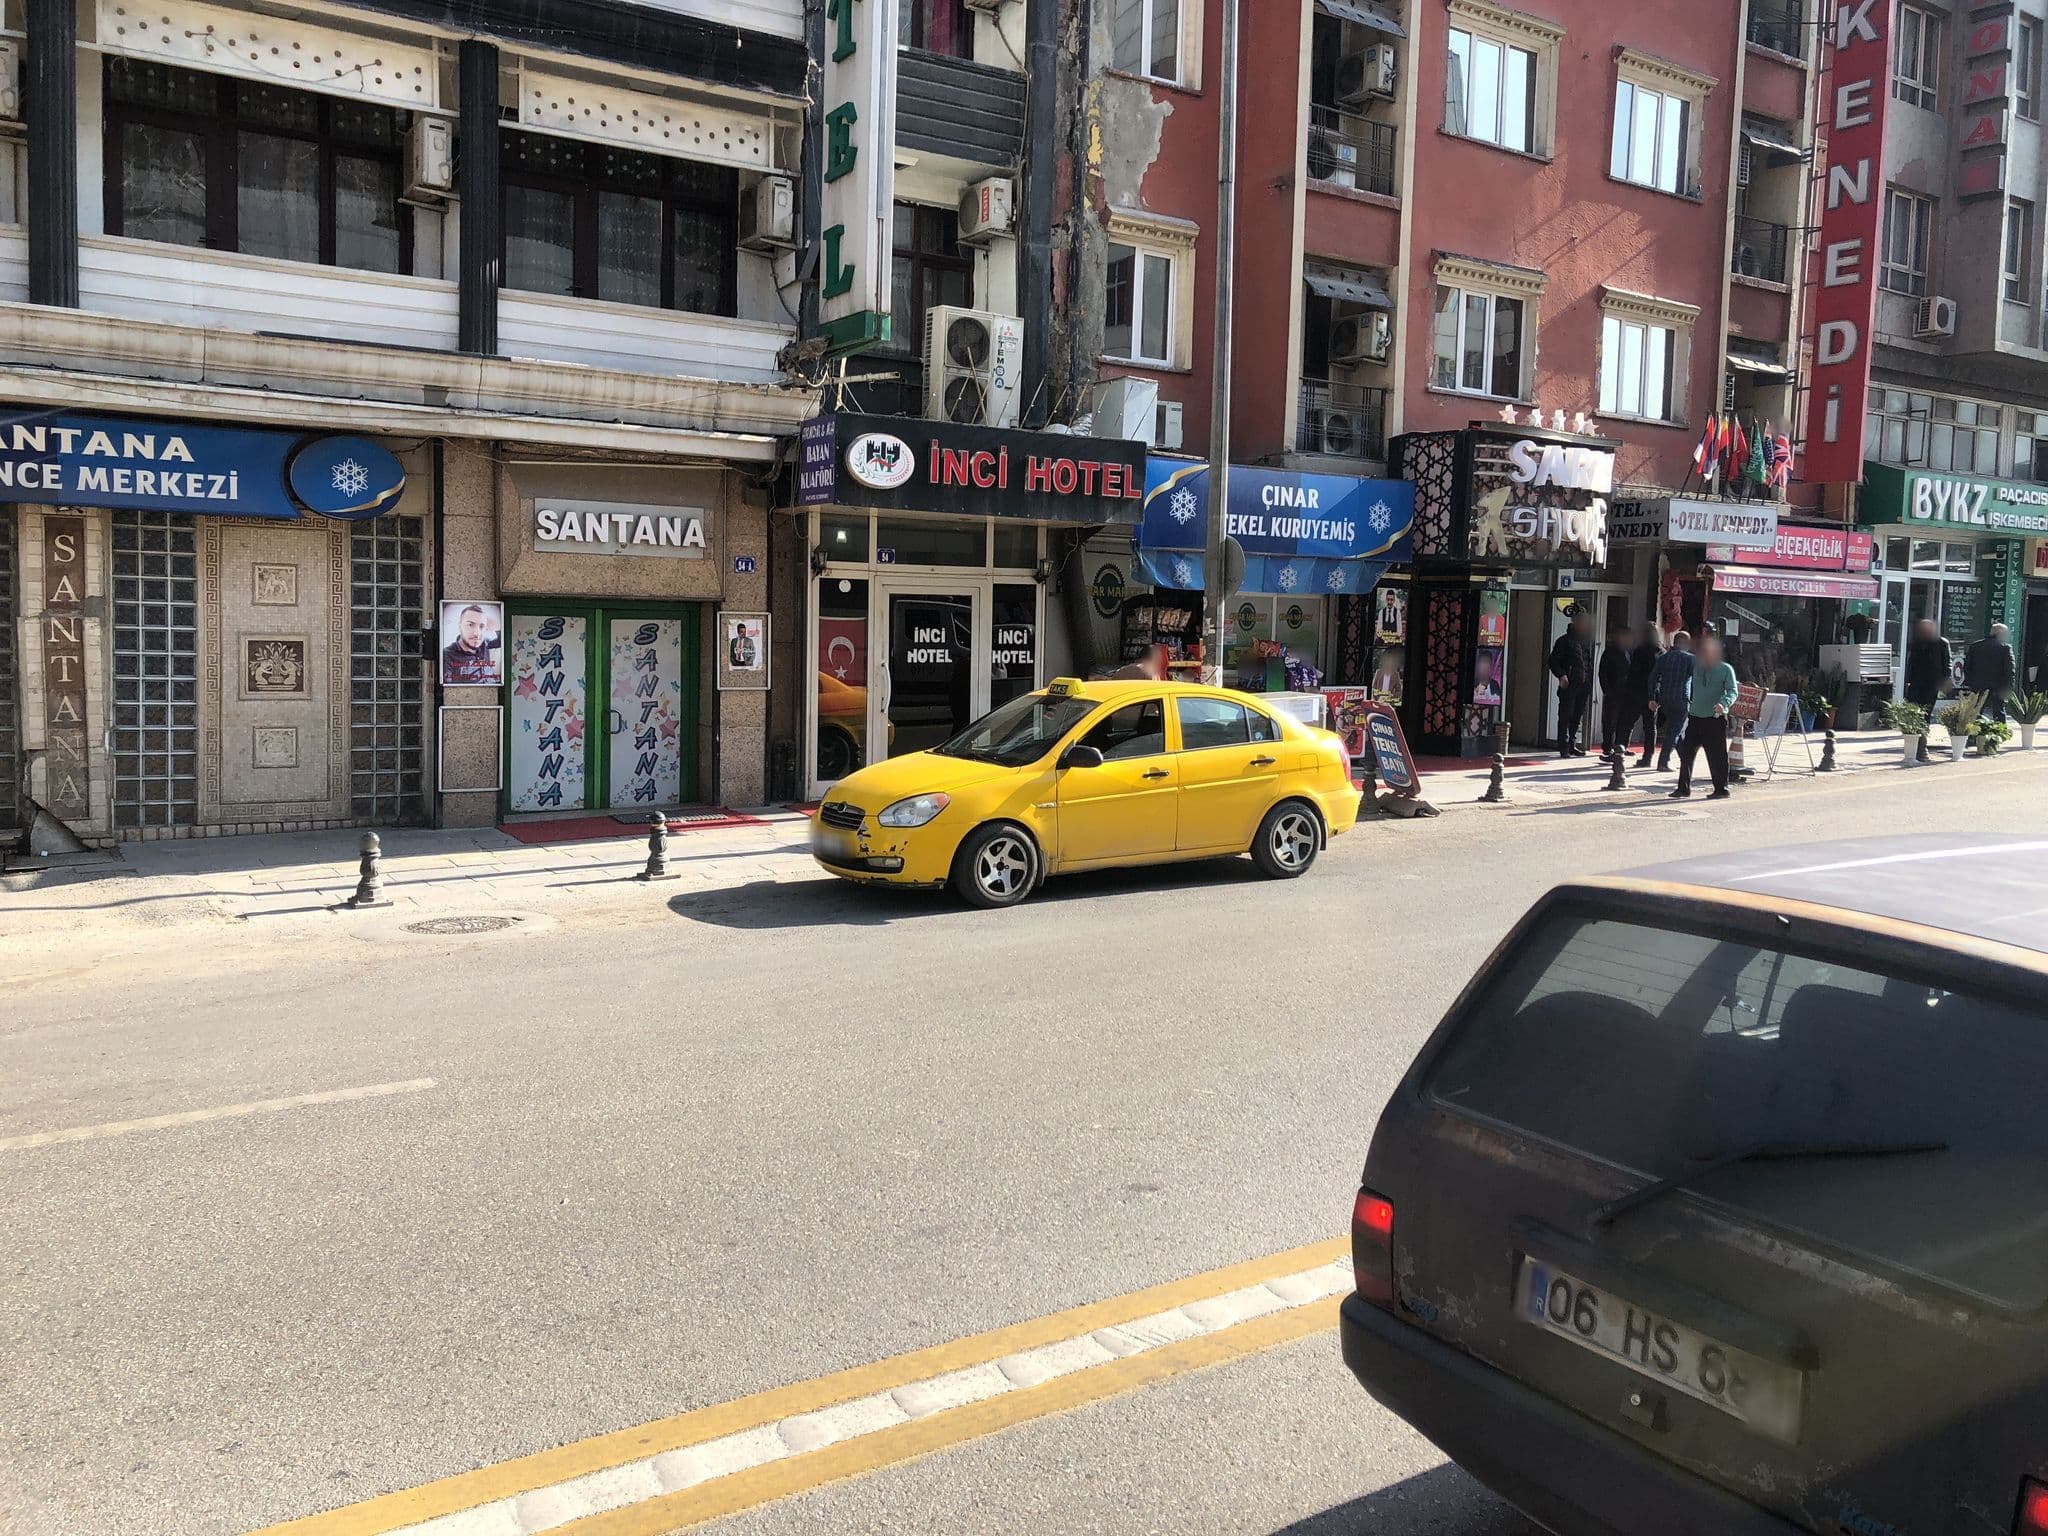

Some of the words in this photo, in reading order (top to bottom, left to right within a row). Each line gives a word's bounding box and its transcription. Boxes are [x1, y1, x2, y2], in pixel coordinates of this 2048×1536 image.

[0, 424, 195, 463] NTANA
[806, 442, 831, 464] BAYAN
[76, 466, 238, 500] MERKEZİ
[930, 439, 1008, 489] İNCİ
[1025, 455, 1142, 498] HOTEL
[1262, 484, 1319, 511] ÇINAR
[1913, 478, 1988, 525] BYKZ
[536, 509, 706, 549] SANTANA
[1225, 513, 1267, 537] EKEL
[1270, 516, 1356, 547] KURUYEMİŞ
[1679, 511, 1709, 533] OTEL
[1711, 514, 1769, 535] KENNEDY
[1723, 575, 1756, 589] ULUS
[914, 627, 946, 643] İNCİ
[998, 629, 1028, 645] İNCİ
[47, 534, 82, 801] SANTANA
[907, 649, 952, 664] HOTEL
[992, 650, 1034, 664] HOTEL
[537, 616, 566, 807] SANTANA
[633, 623, 660, 803] SANTANA
[1549, 1277, 1599, 1337] 06
[1623, 1308, 1680, 1374] HS
